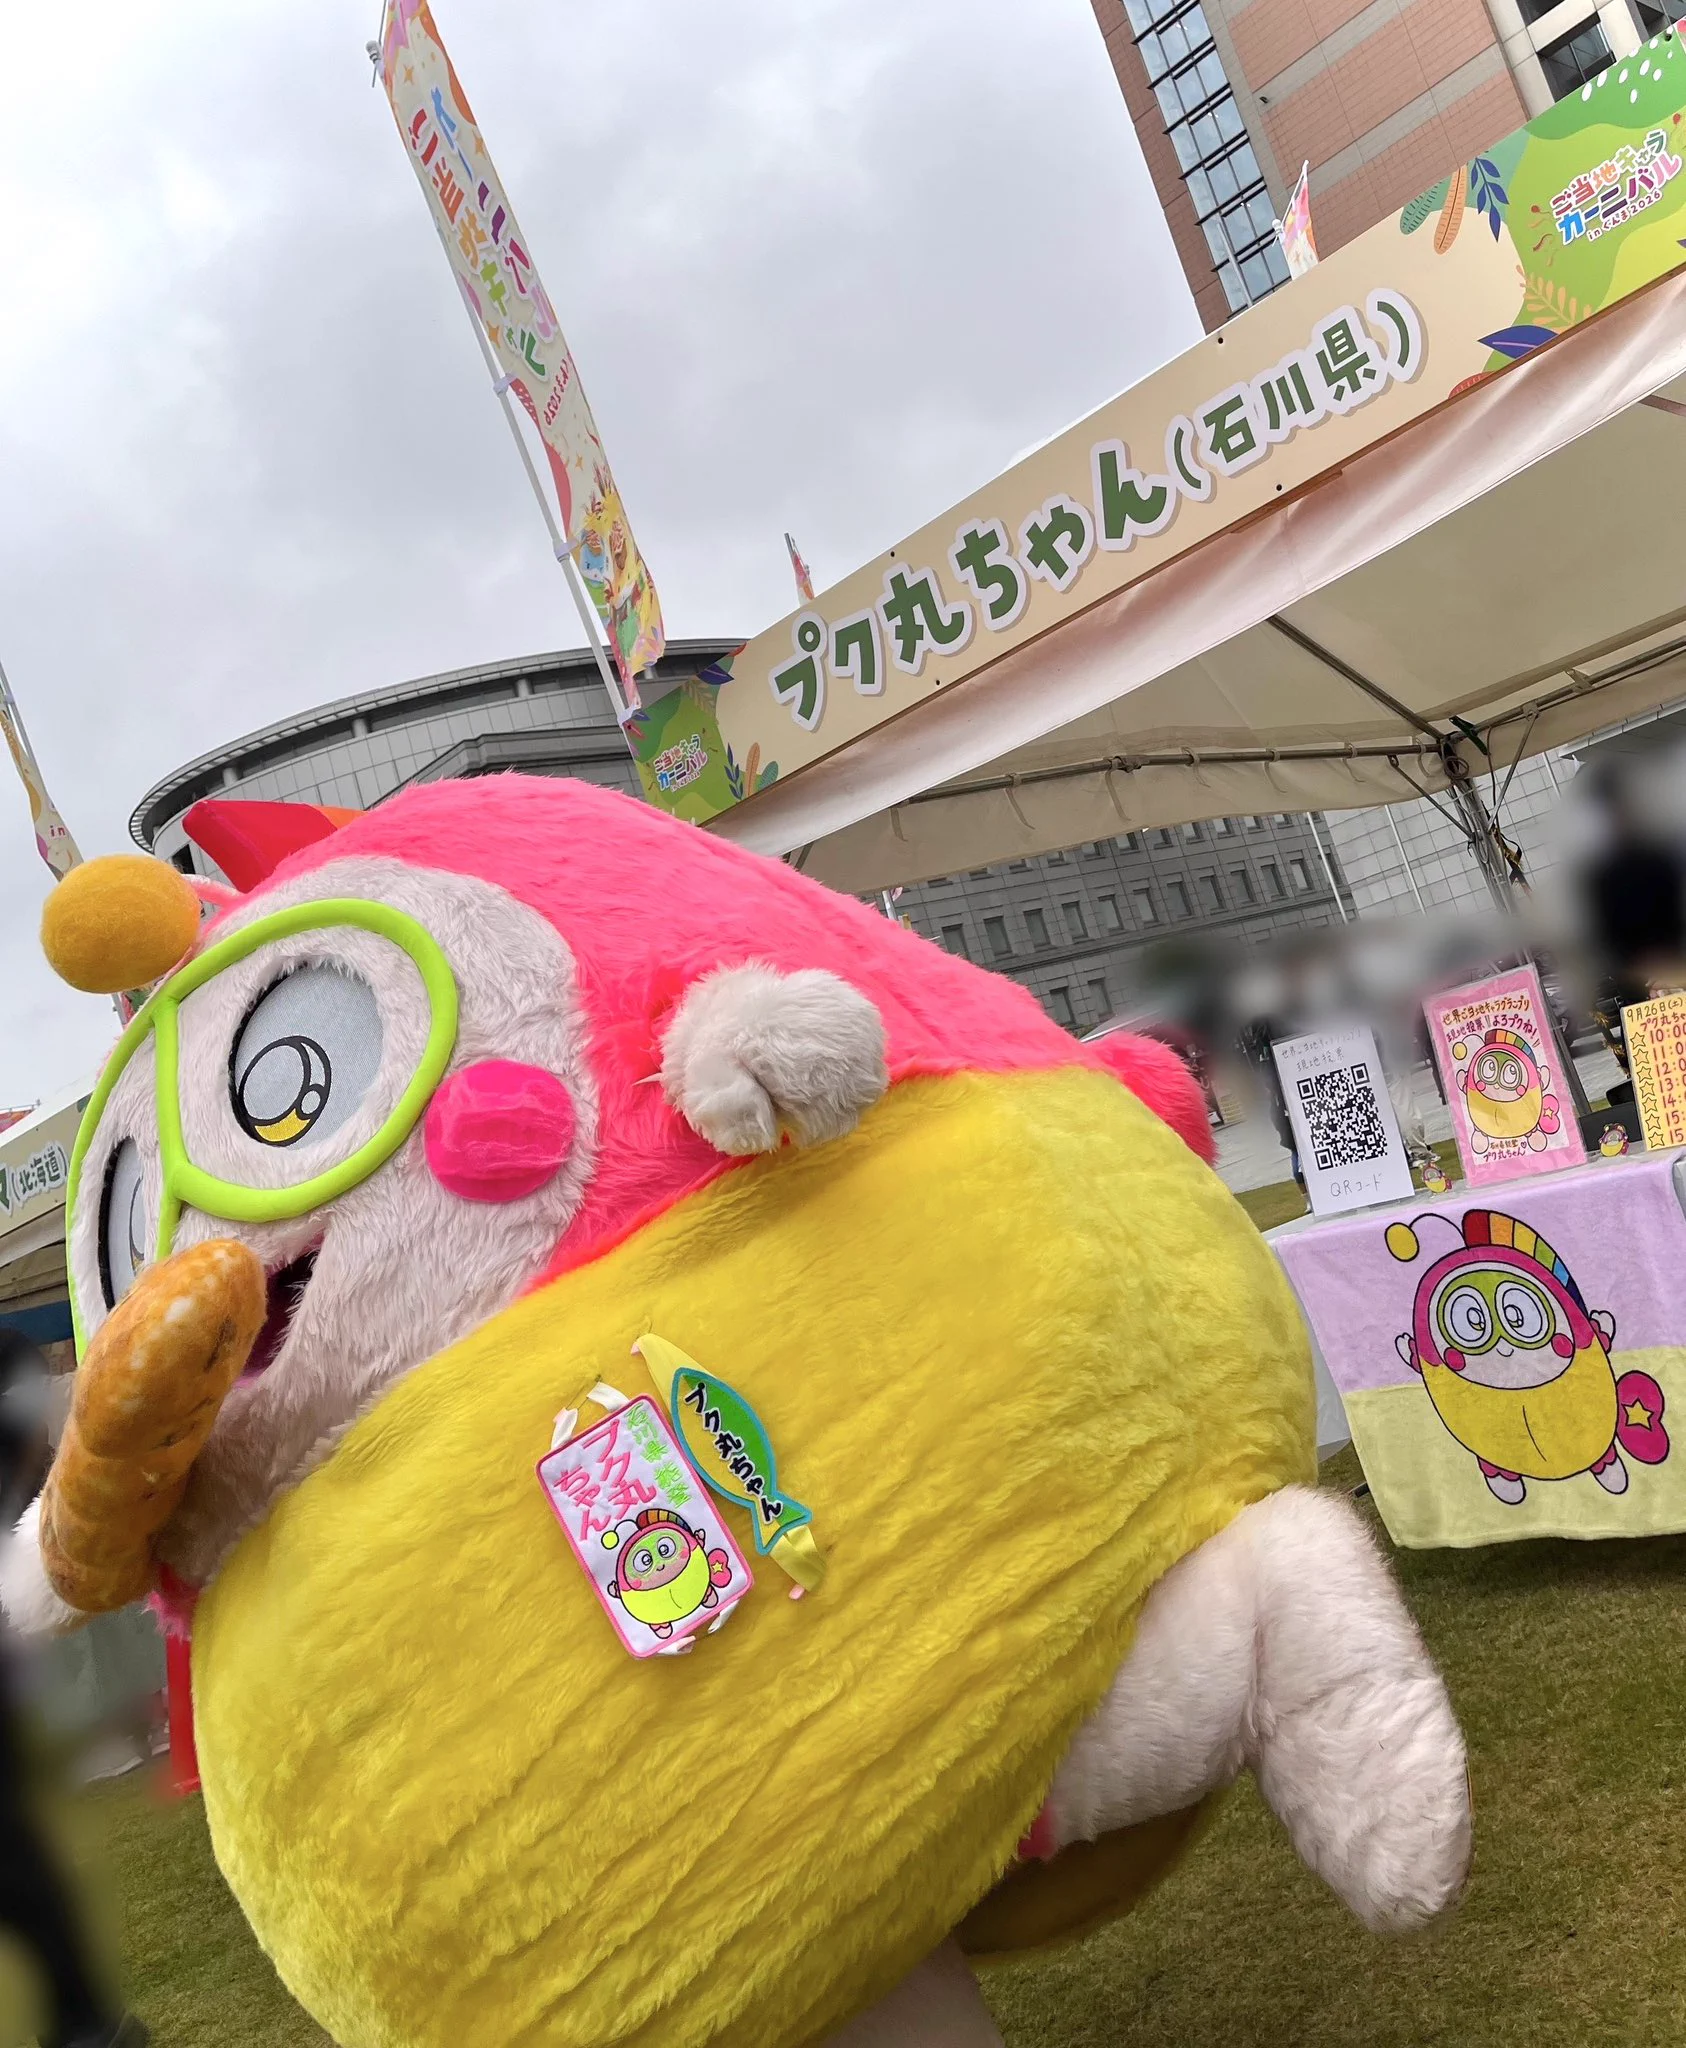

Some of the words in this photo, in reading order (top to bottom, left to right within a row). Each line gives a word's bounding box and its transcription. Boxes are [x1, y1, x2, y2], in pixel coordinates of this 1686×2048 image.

[1552, 131, 1665, 217] ご当地キャラ
[1557, 153, 1681, 243] カーニバル
[1588, 228, 1601, 240] in
[658, 751, 707, 790] カーニバル
[50, 826, 66, 837] in
[1652, 1041, 1686, 1062] 11:0
[1330, 1172, 1382, 1197] QRコード
[685, 1382, 782, 1523] プク丸ちゃん
[553, 1464, 608, 1541] ちゃん
